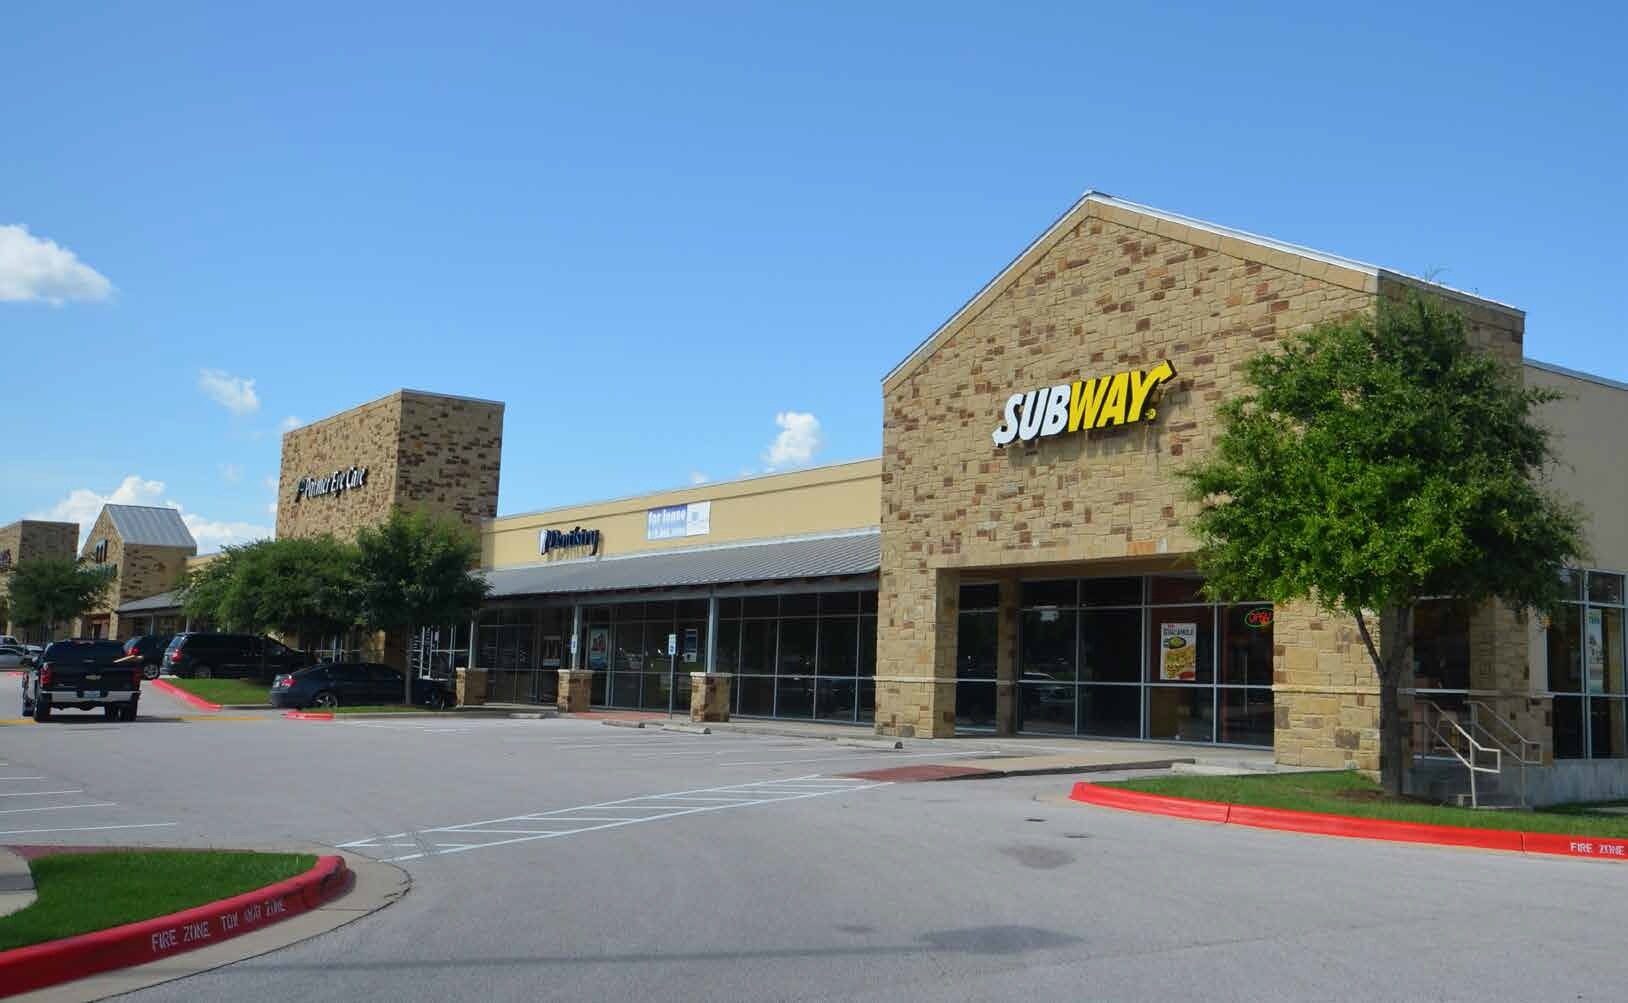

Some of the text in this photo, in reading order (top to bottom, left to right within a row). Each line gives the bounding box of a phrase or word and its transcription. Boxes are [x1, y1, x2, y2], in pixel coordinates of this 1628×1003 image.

[992, 360, 1173, 447] SUBWAY
[1569, 842, 1625, 855] FIRE ZONE
[151, 929, 178, 952] FIRE
[183, 920, 211, 942] ZONE
